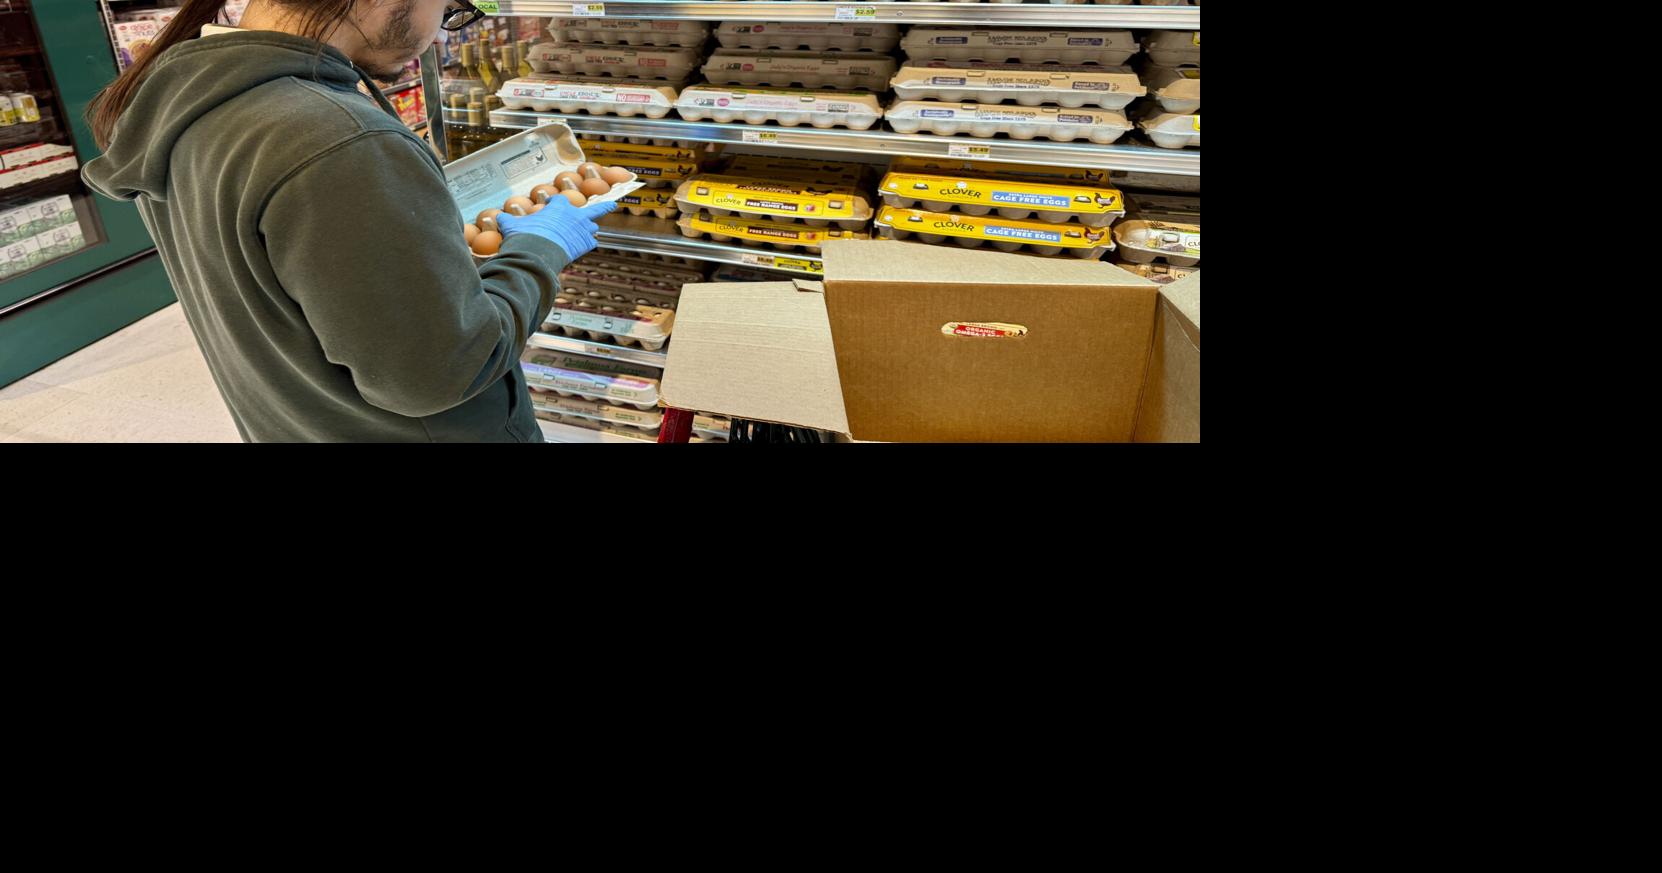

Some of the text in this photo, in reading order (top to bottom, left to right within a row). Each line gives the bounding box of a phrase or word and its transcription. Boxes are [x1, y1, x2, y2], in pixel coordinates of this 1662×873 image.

[939, 188, 982, 198] CLOVER
[716, 198, 741, 206] CLOVER
[1018, 196, 1040, 204] FREE
[933, 220, 975, 231] CLOVER
[1011, 230, 1033, 238] FREE
[965, 326, 996, 334] ORGANIC
